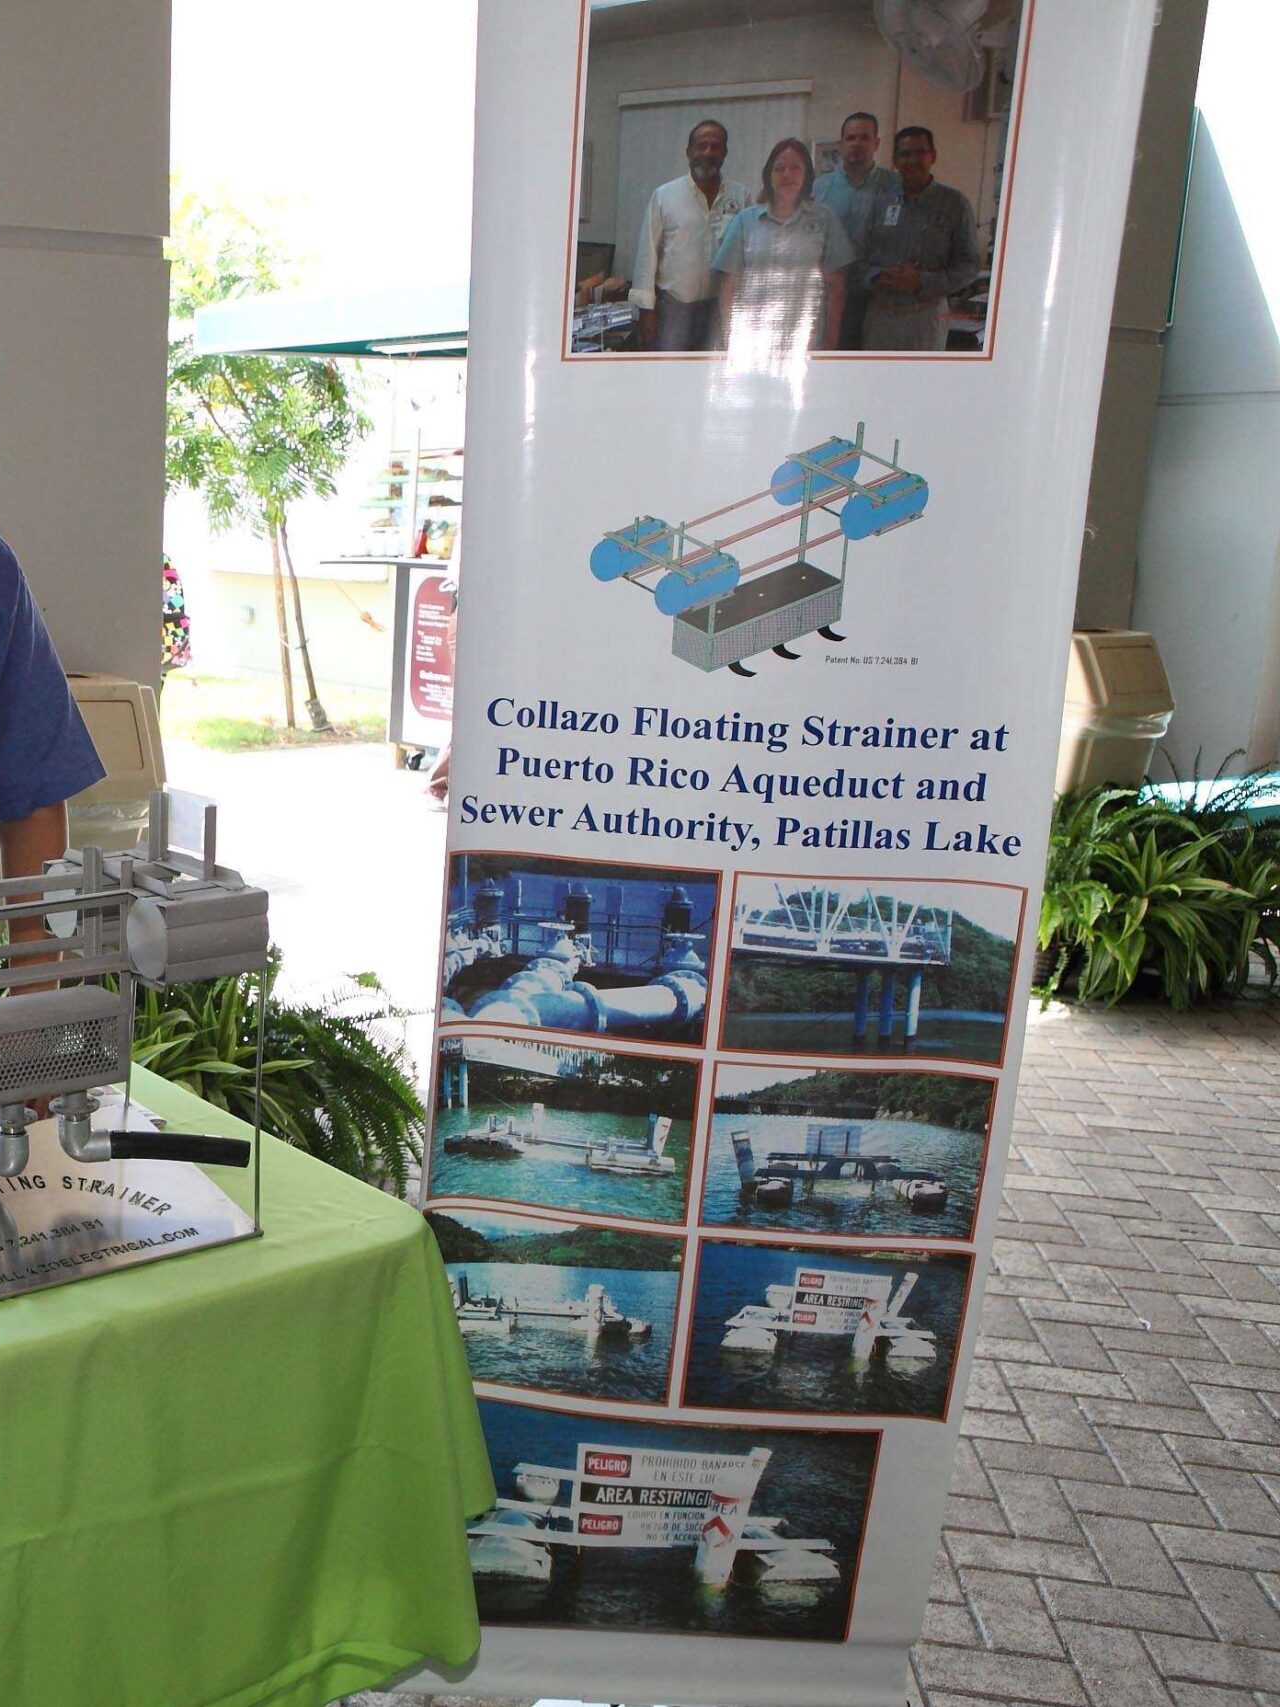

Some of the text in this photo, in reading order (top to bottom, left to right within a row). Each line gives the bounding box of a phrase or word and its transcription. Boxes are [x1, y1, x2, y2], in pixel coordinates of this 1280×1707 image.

[825, 655, 848, 664] Patent
[863, 656, 873, 664] US
[486, 697, 1010, 754] Collazo Floating Strainer at
[496, 747, 987, 804] Puerto Rico Aqueduct and
[460, 795, 1022, 857] Sewer Authority, Patillas Lake
[63, 1176, 172, 1216] STRAINER
[82, 1218, 104, 1233] B1
[803, 1293, 824, 1305] AREA
[587, 1457, 628, 1472] PELIGRO
[641, 1455, 697, 1469] PROHIBIDO
[596, 1486, 633, 1504] AREA
[582, 1518, 619, 1531] PELIGRO
